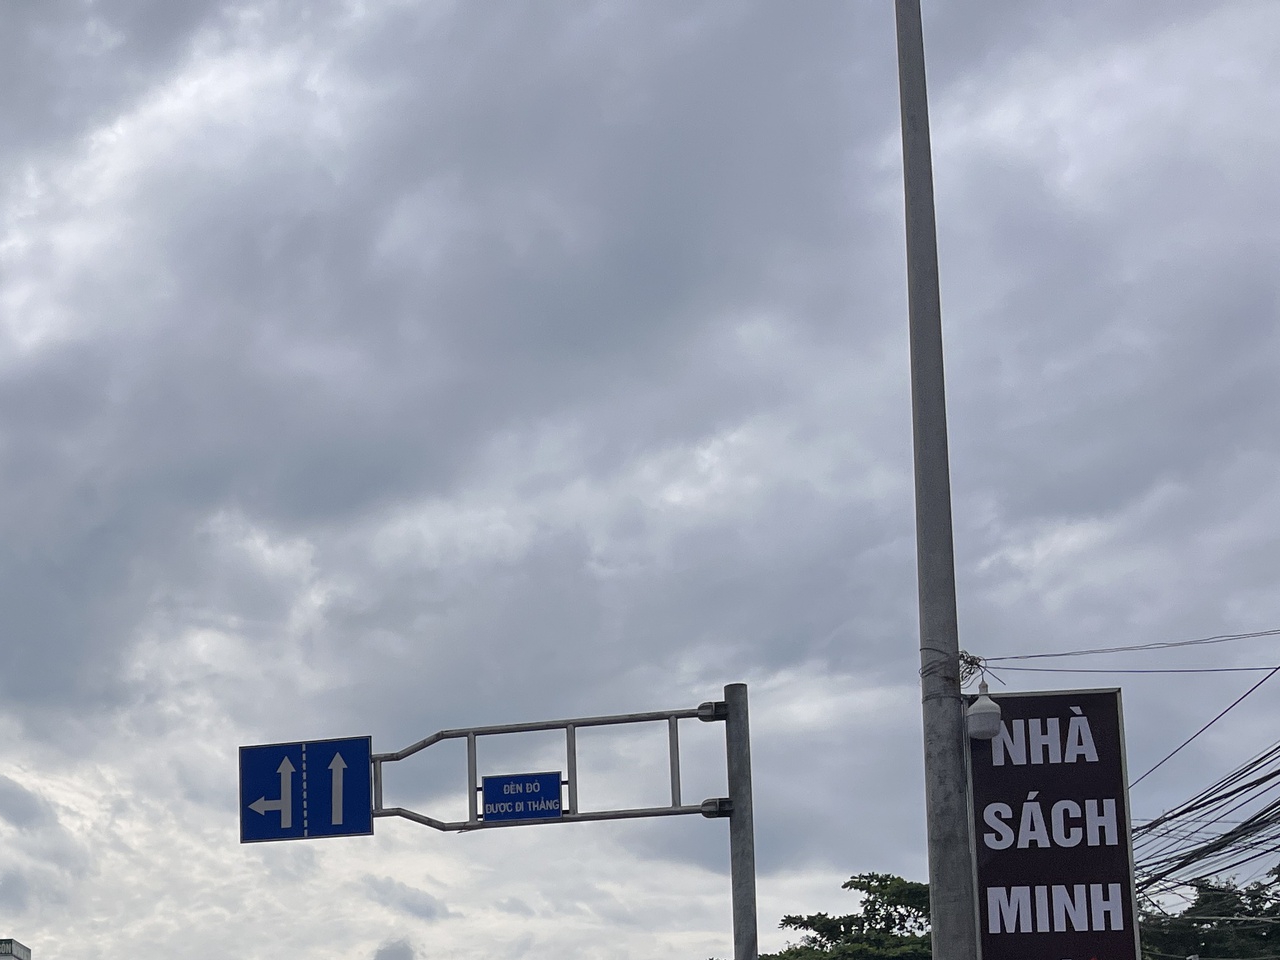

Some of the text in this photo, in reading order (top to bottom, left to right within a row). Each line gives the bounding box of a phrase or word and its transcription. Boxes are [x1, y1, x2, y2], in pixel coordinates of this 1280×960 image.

[990, 705, 1099, 767] NHÀ
[982, 790, 1119, 851] SÁCH
[986, 882, 1124, 935] MINH
